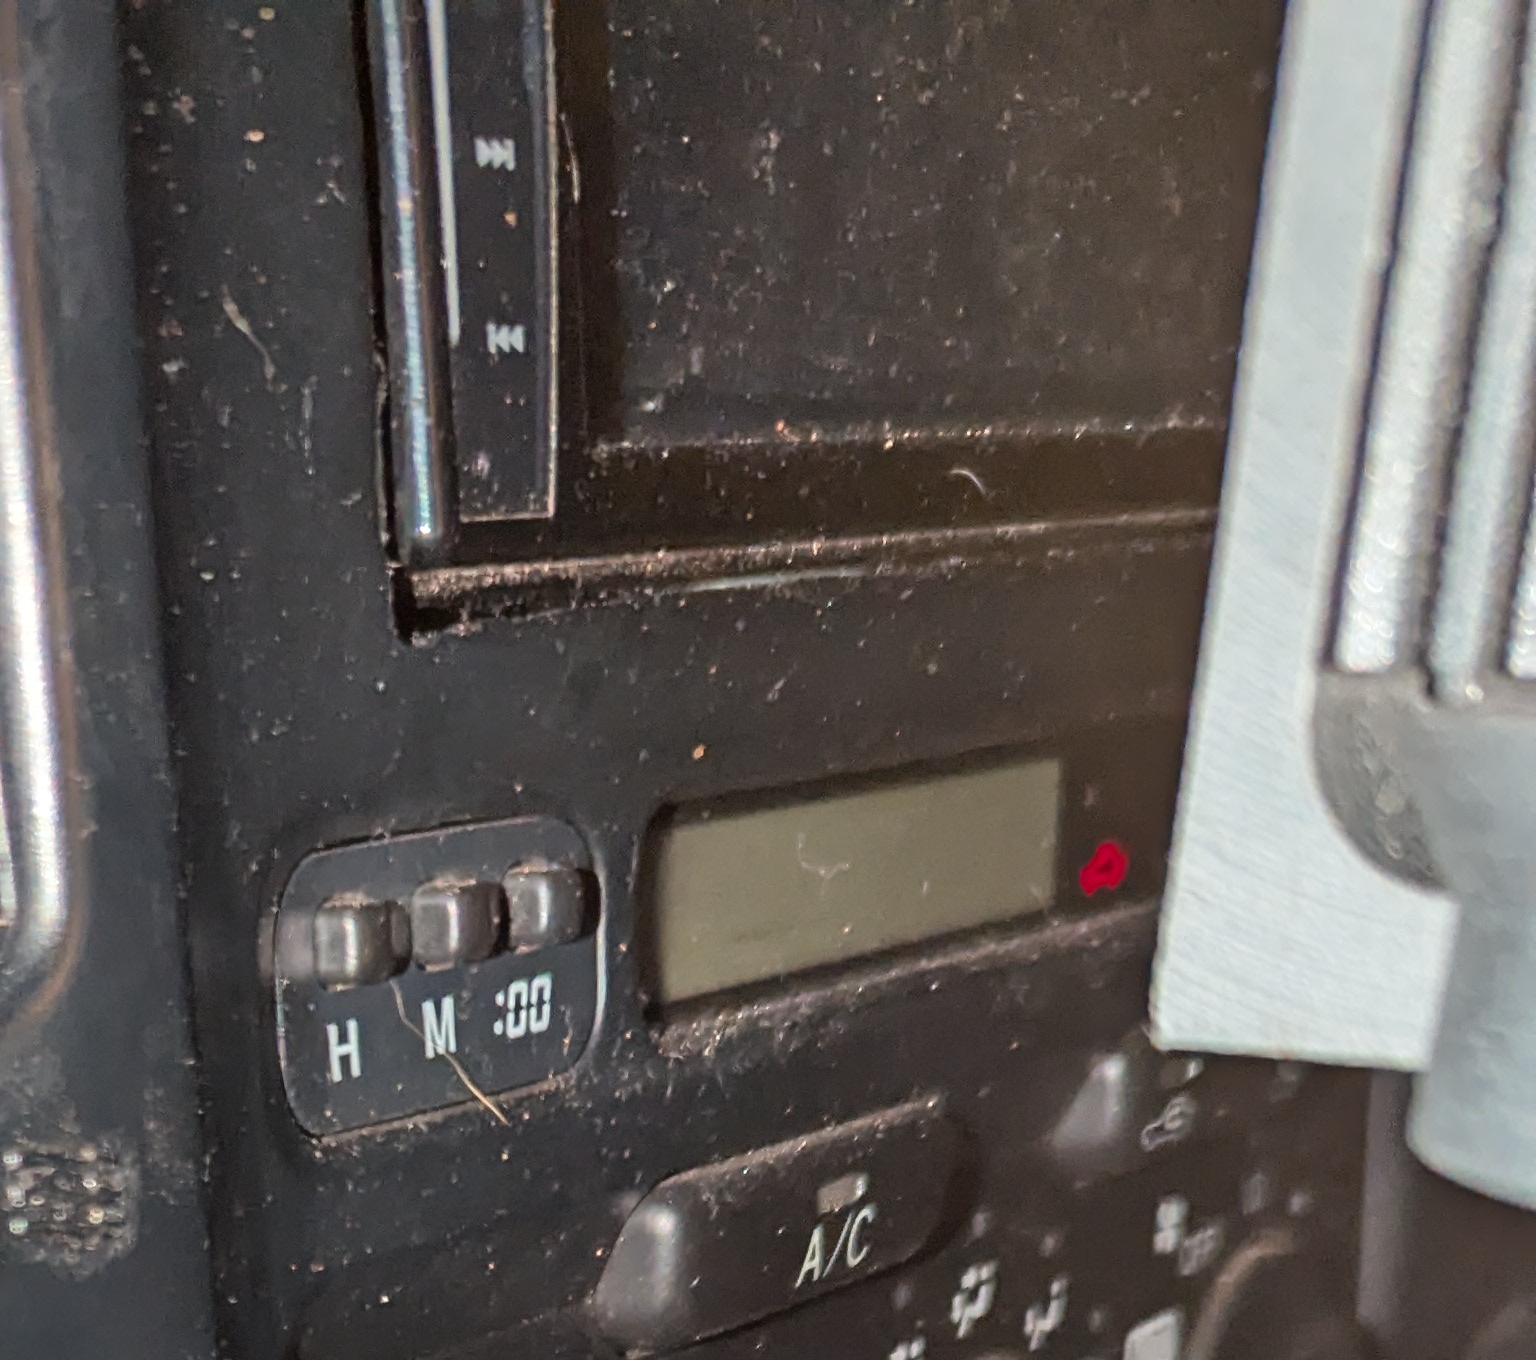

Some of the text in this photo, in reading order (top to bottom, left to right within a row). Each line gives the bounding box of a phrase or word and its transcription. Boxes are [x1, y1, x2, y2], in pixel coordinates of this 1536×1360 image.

[326, 1019, 361, 1083] H
[421, 995, 458, 1058] M
[794, 1206, 875, 1287] A/C
